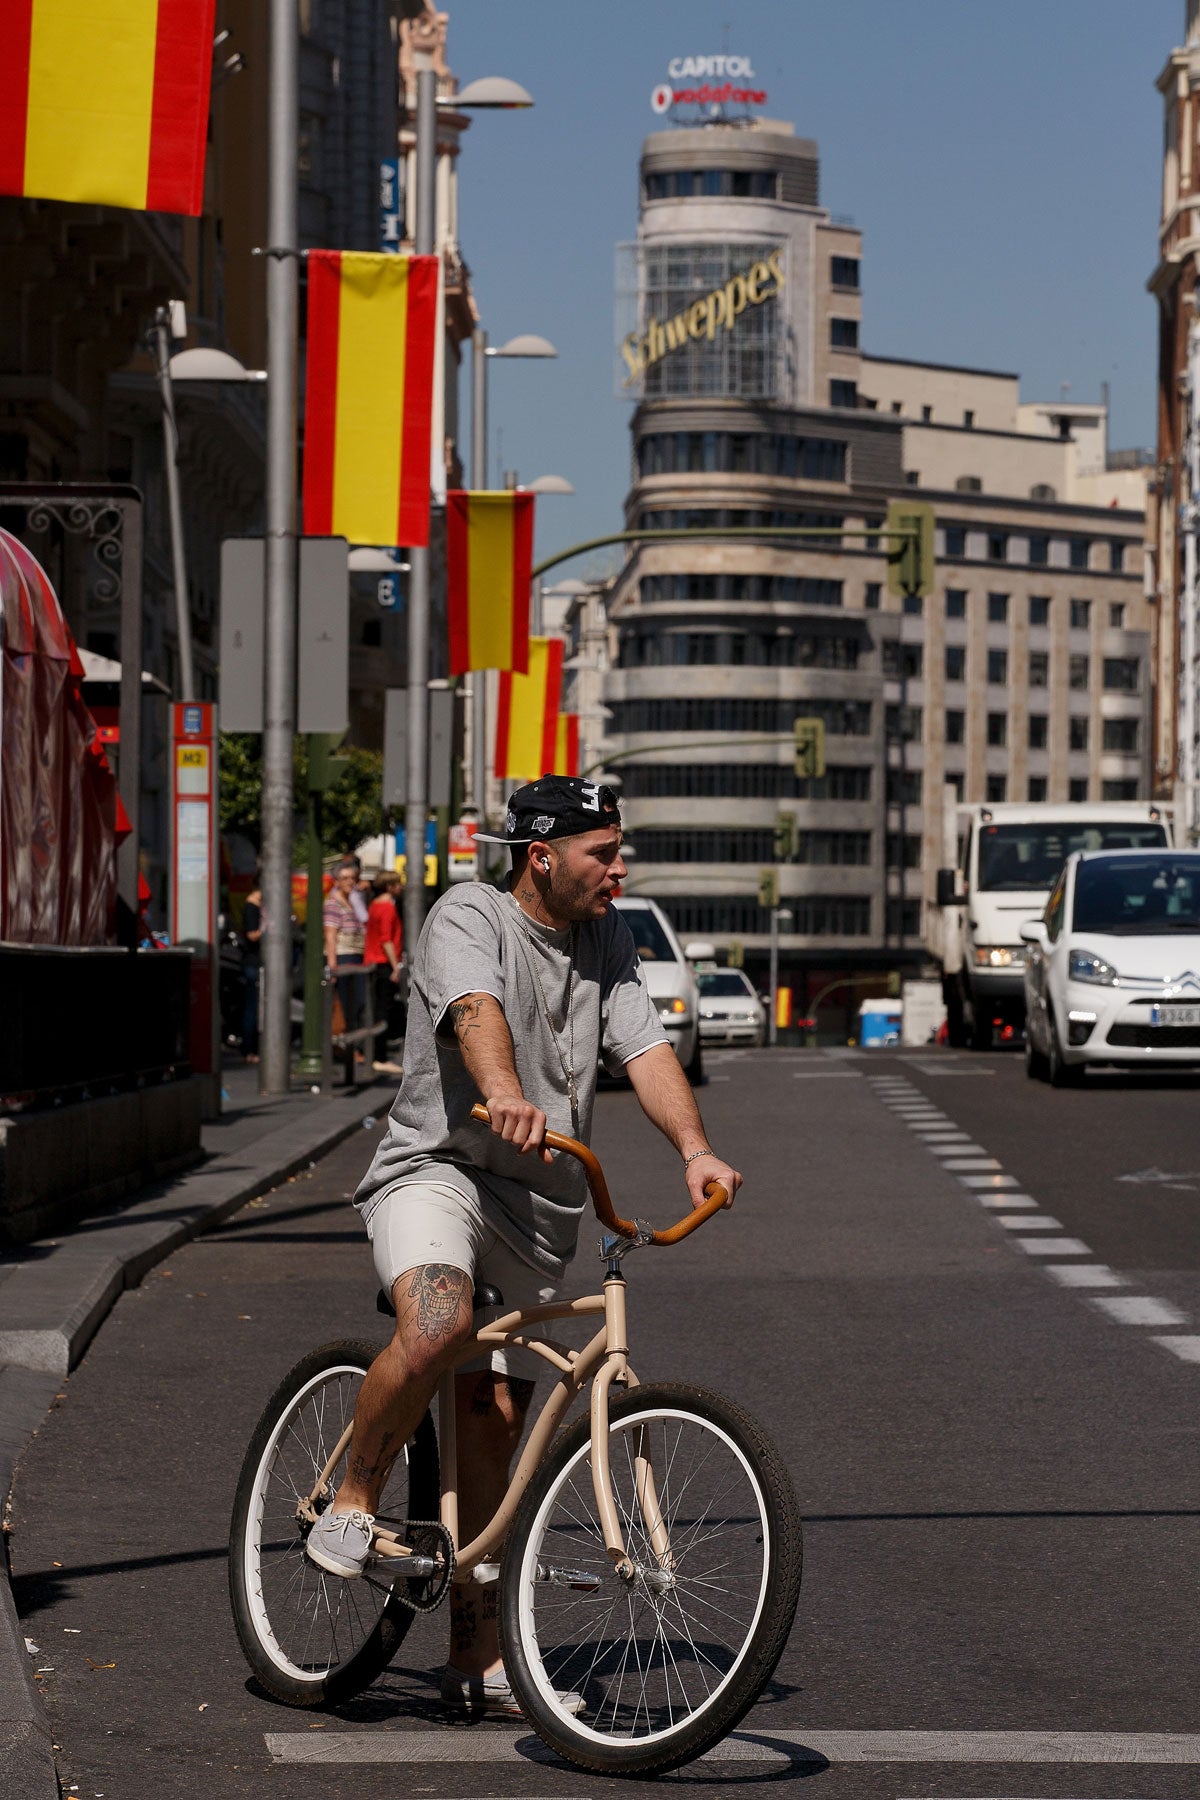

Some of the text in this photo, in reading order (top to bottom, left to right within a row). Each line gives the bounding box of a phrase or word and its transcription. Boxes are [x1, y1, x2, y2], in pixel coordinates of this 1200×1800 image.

[668, 54, 756, 79] CAPITOL
[672, 82, 767, 105] vodafone
[621, 248, 784, 388] Schweppes
